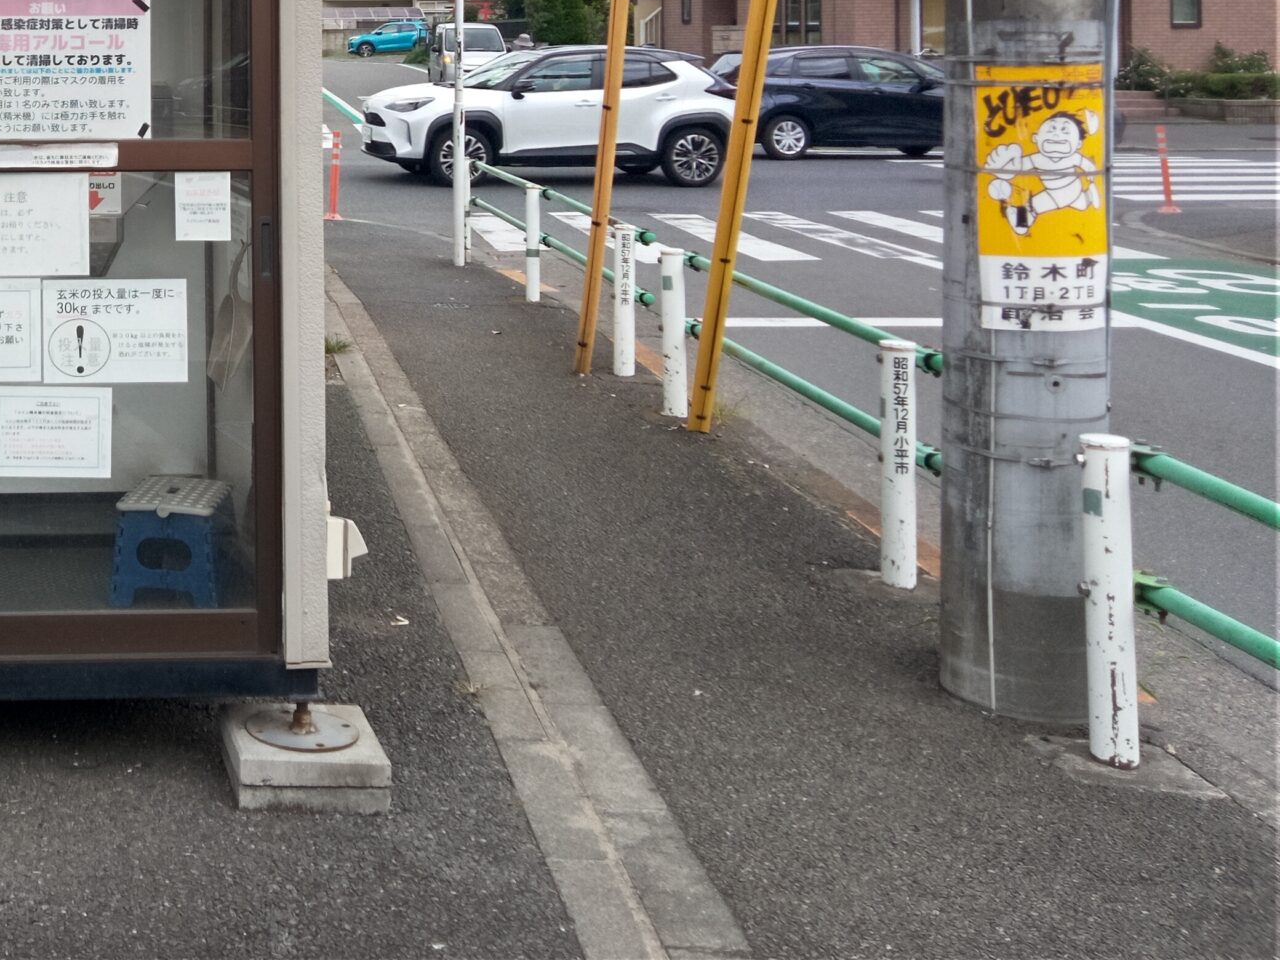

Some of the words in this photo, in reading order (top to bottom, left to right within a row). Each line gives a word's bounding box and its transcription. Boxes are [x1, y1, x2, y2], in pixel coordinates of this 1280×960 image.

[28, 2, 67, 14] お願い
[3, 191, 28, 203] 注意
[1001, 262, 1094, 281] 鈴木町
[56, 287, 175, 300] 玄米の投入量は一度に
[1003, 285, 1095, 301] 1丁目・2丁目
[56, 302, 88, 315] 30kg
[92, 303, 140, 315] までです。
